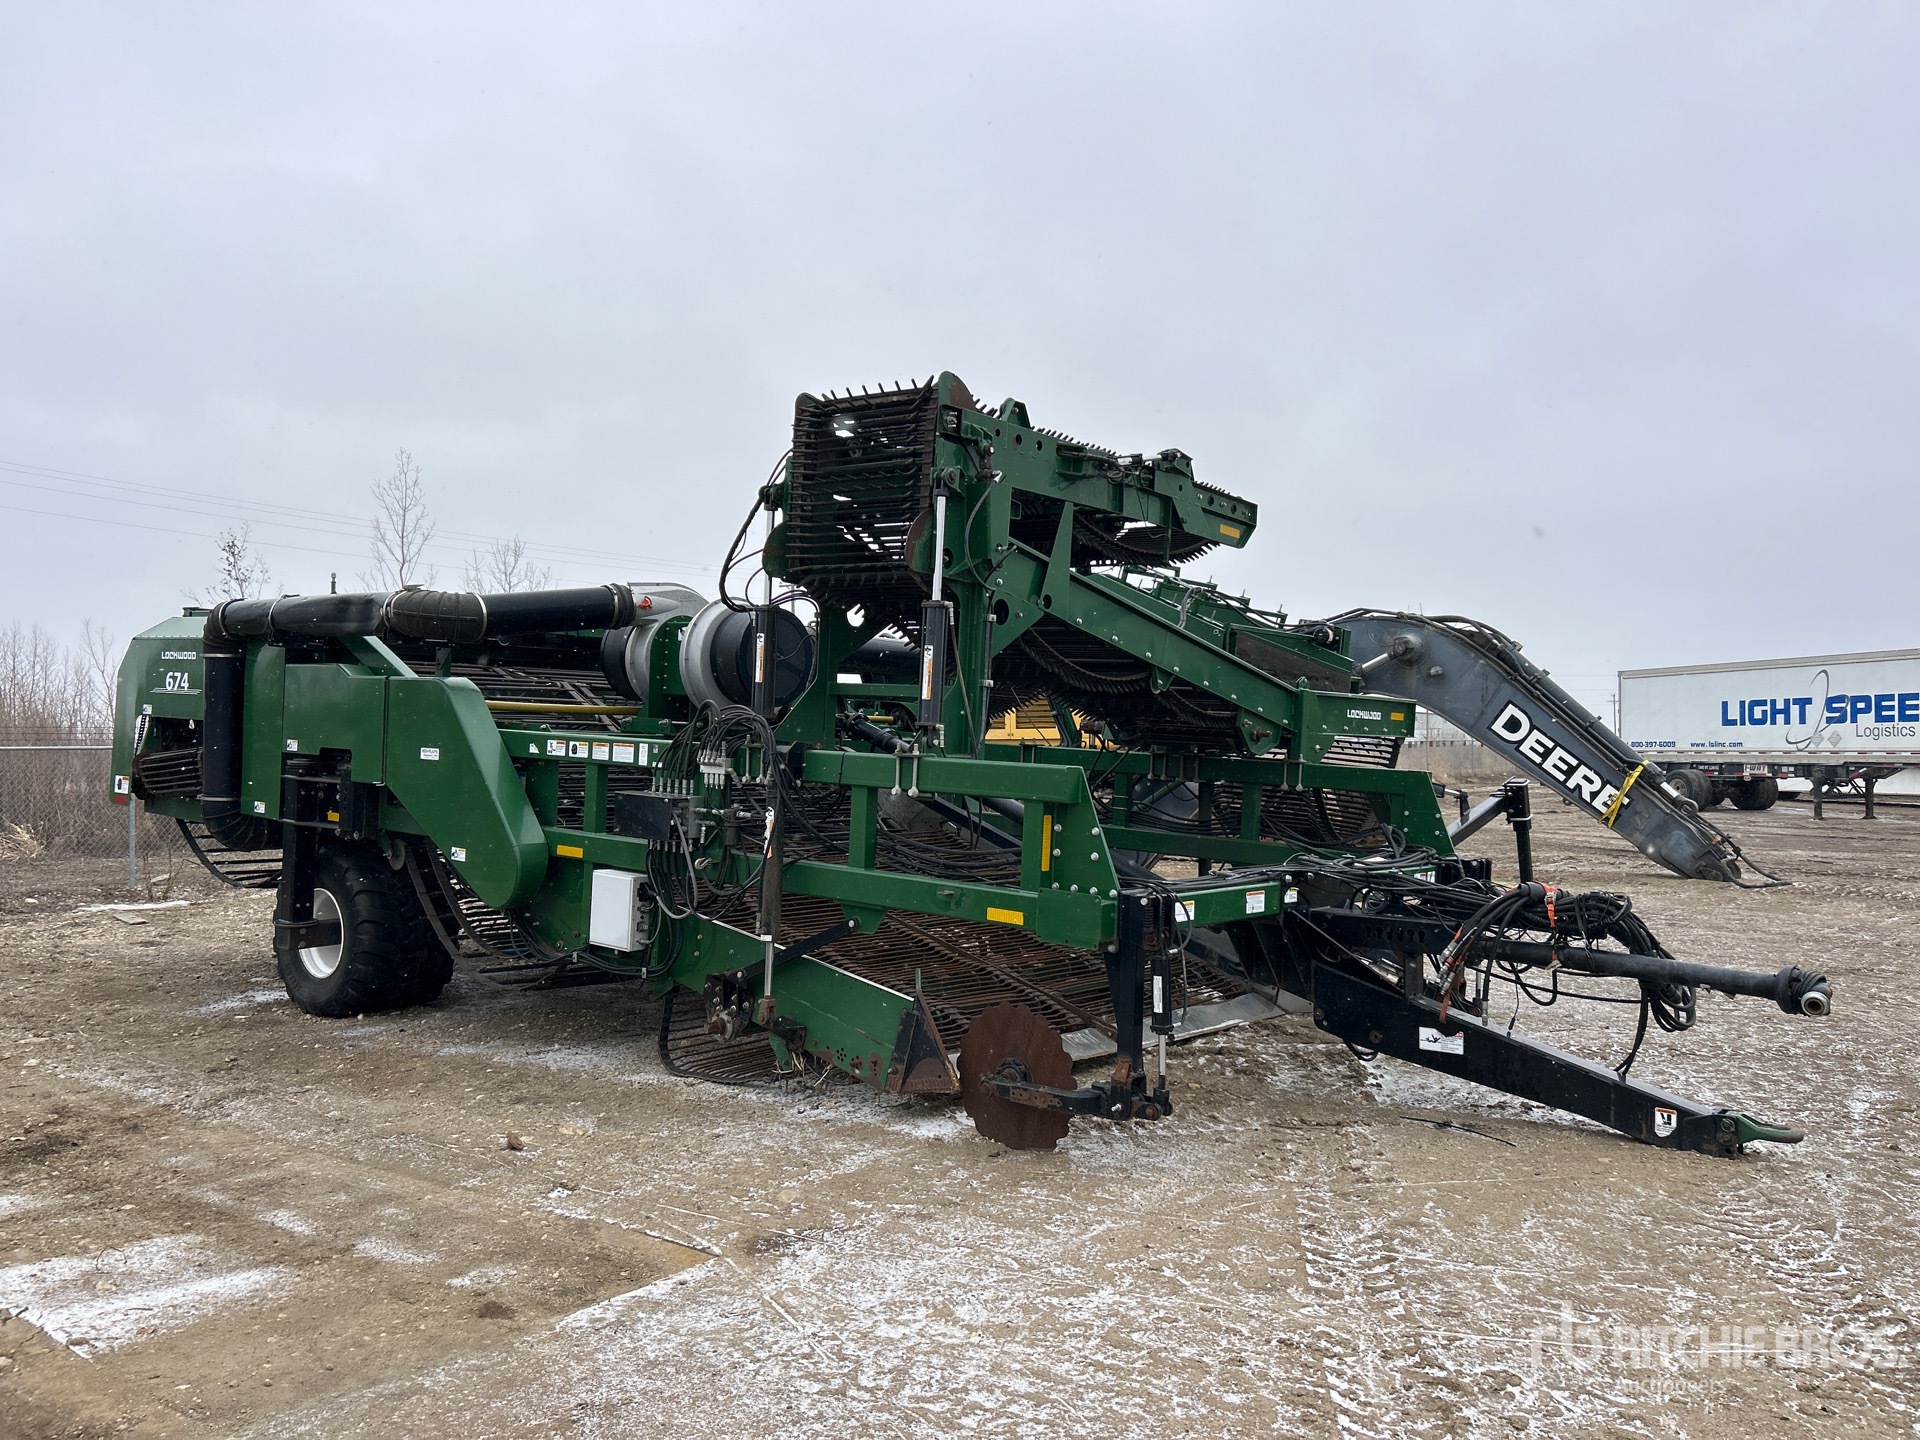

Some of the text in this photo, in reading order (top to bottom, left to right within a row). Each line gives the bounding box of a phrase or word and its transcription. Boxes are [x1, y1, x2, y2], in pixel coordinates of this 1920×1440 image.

[161, 651, 197, 660] LOCKWOOD
[166, 671, 189, 691] 674
[1346, 709, 1381, 720] LOCKWOOD
[1721, 692, 1920, 726] LIGHT SPEE
[1856, 723, 1916, 741] Logistics
[1490, 703, 1631, 814] DEERE
